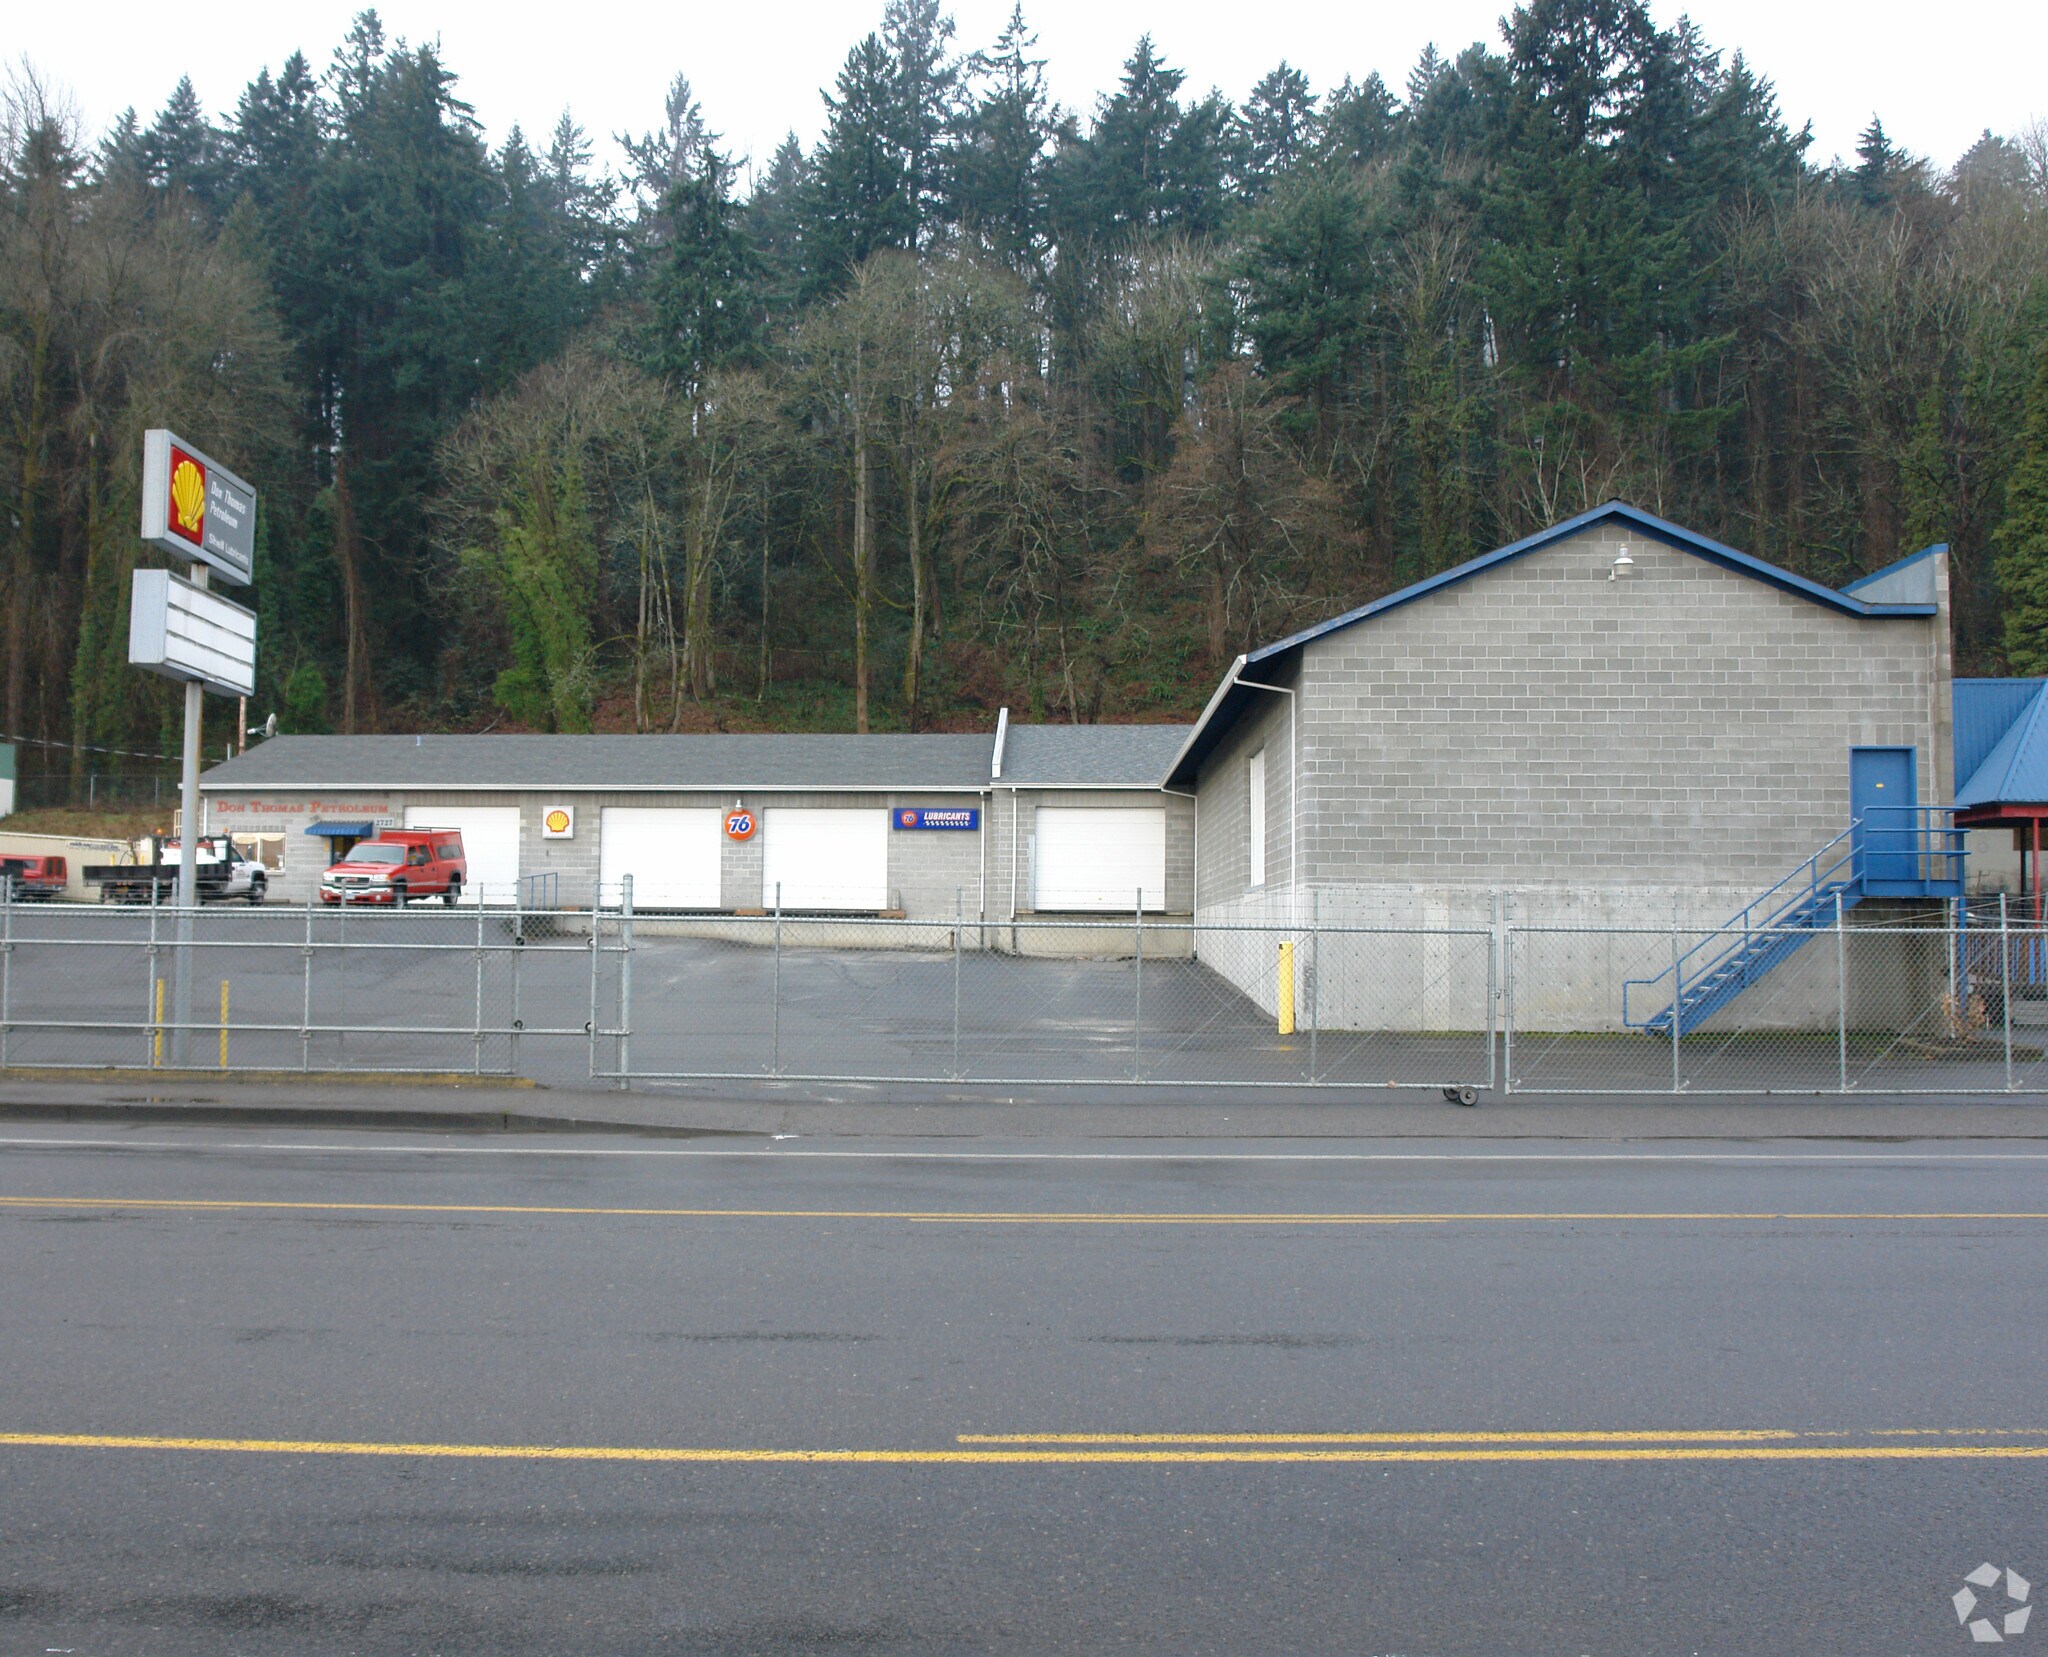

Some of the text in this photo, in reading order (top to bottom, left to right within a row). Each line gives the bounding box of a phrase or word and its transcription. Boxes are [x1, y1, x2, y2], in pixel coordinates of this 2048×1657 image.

[211, 481, 246, 514] Don Thomas
[209, 500, 238, 529] Petroleum
[208, 533, 224, 552] Shell
[728, 814, 752, 834] 76
[903, 814, 915, 823] 76
[923, 811, 971, 821] LUBRICANTS
